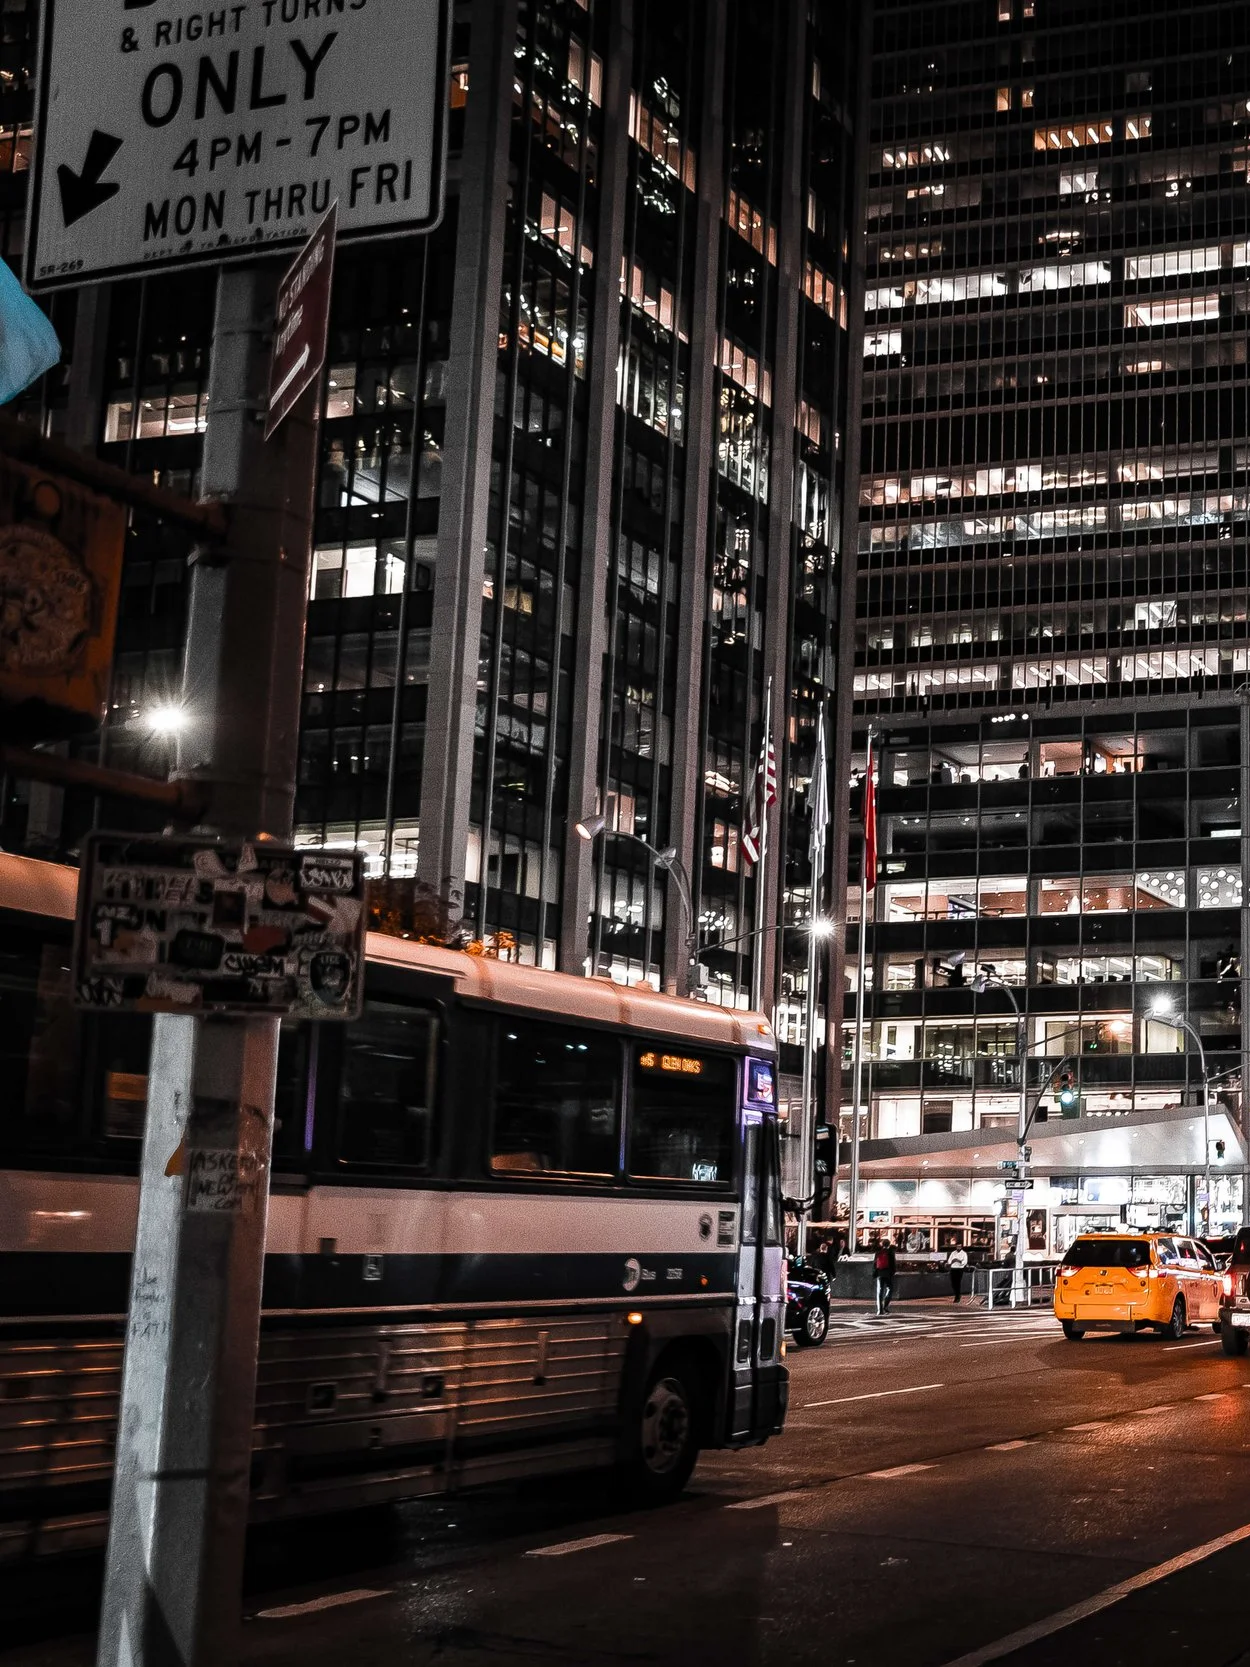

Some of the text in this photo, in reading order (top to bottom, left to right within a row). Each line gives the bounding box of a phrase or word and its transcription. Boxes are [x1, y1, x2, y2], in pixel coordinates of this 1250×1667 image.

[120, 26, 141, 53] &
[155, 5, 247, 48] RIGHT
[141, 32, 339, 128] ONLY
[143, 160, 412, 241] MON THRU FRI
